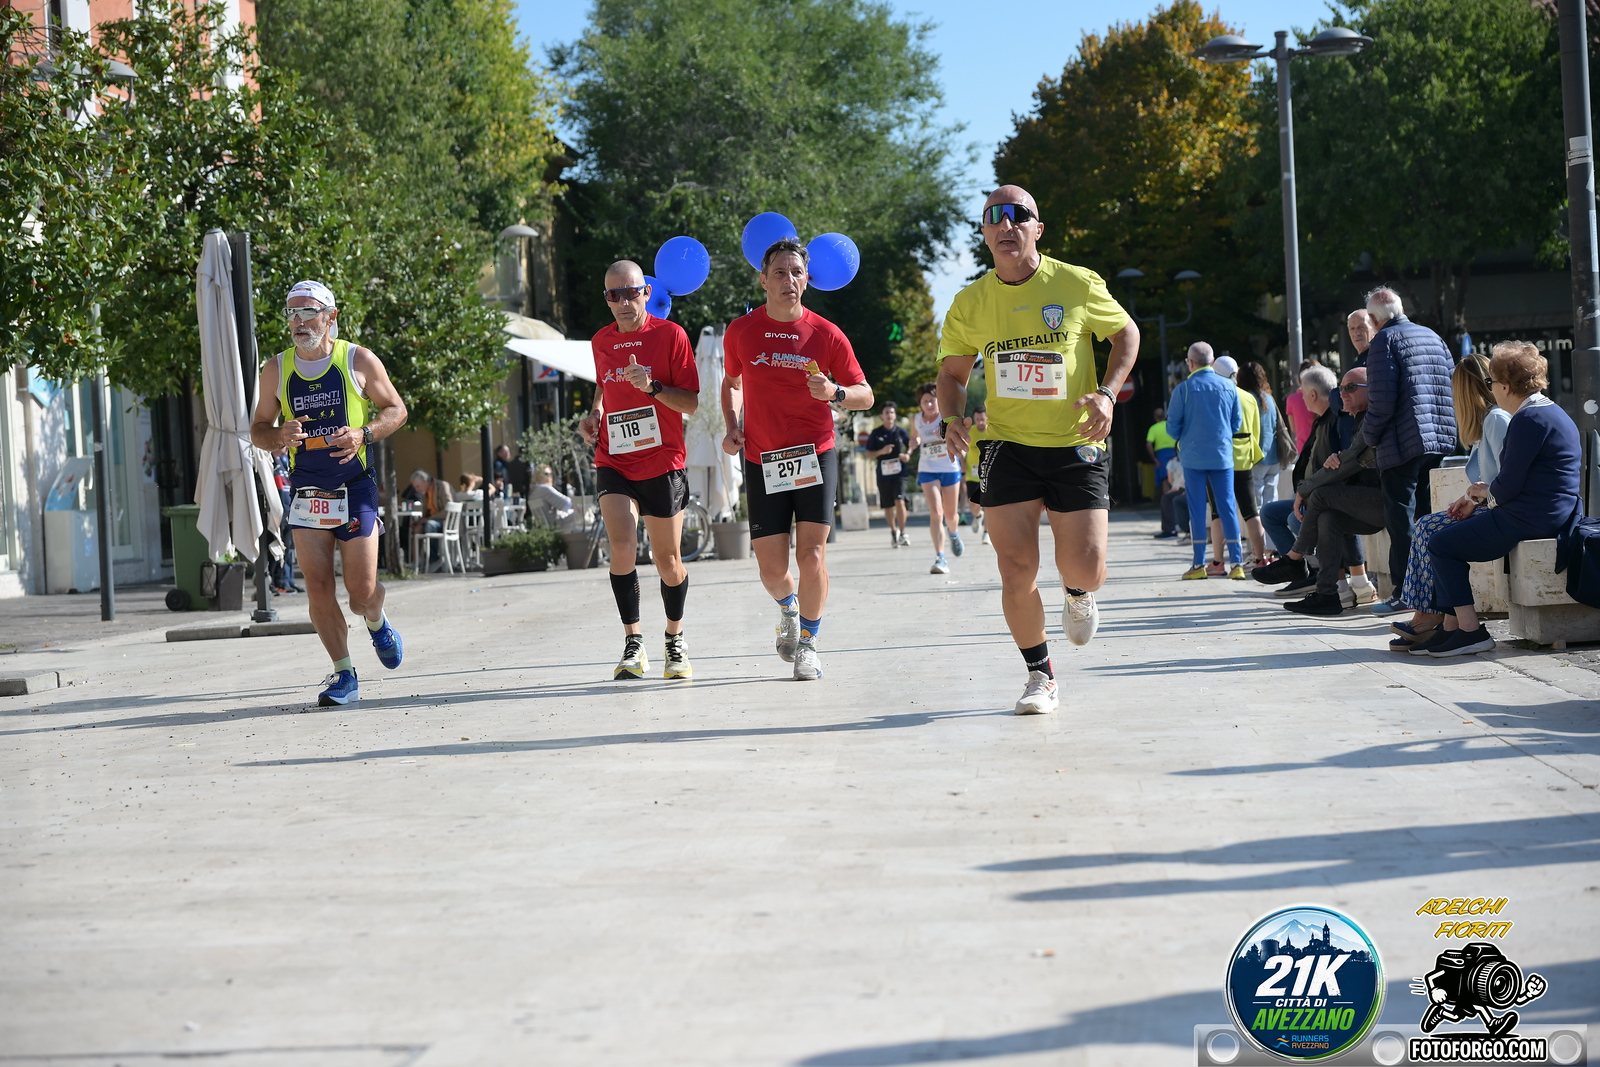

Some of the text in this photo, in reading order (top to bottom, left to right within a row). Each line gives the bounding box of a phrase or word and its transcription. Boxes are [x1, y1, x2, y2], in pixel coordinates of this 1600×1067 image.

[764, 332, 799, 340] GIVOVA
[997, 331, 1069, 352] NETREALITY
[613, 341, 643, 350] GIVOVA
[1017, 364, 1044, 383] 175
[294, 390, 340, 411] BRIGANTI
[620, 421, 641, 439] 118
[770, 452, 783, 460] 21K
[777, 459, 802, 478] 297
